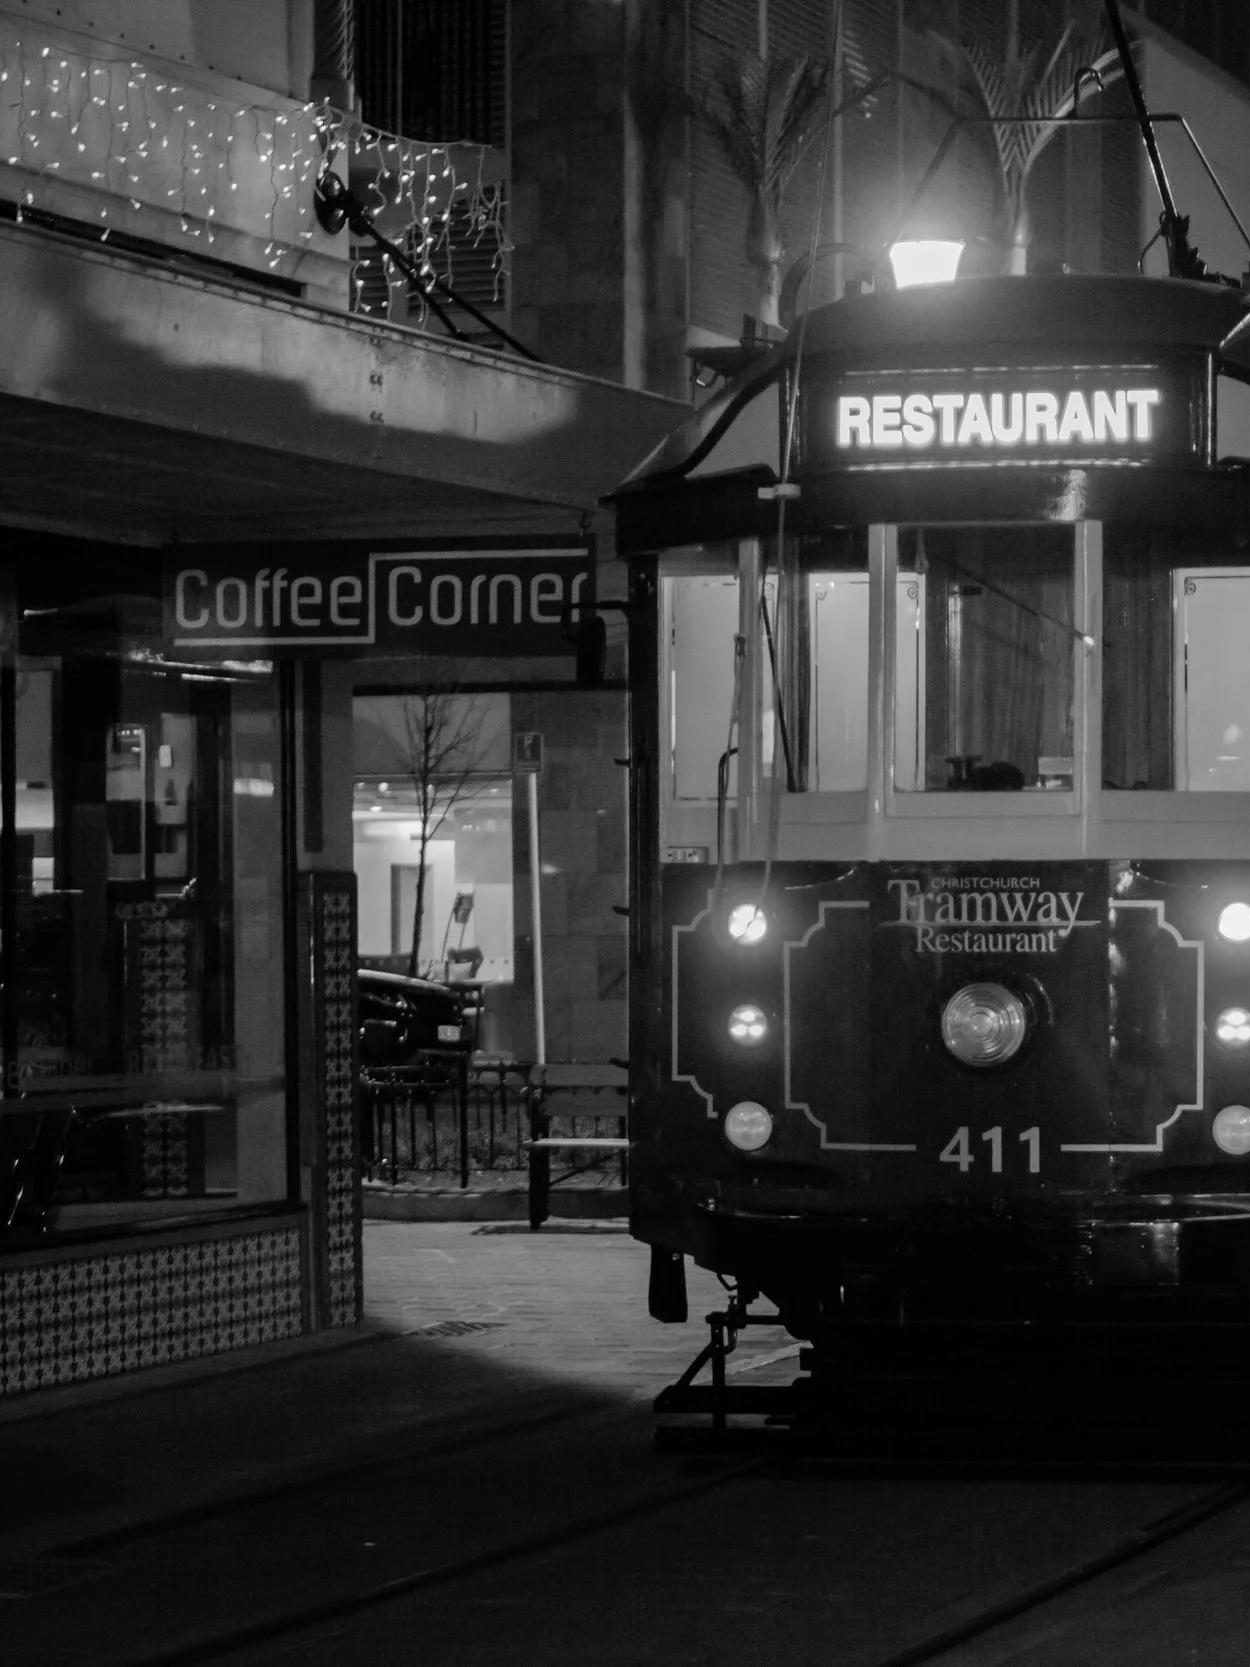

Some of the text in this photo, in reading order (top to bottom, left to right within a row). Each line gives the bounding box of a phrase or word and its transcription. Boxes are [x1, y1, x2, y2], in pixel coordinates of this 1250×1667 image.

[837, 389, 1159, 445] RESTAURANT
[175, 566, 588, 629] Coffee Corner
[888, 879, 1084, 938] Tramway
[931, 877, 1040, 889] CHRISTCHURCH
[915, 926, 1058, 953] Restaurant
[939, 1126, 1041, 1174] 411
